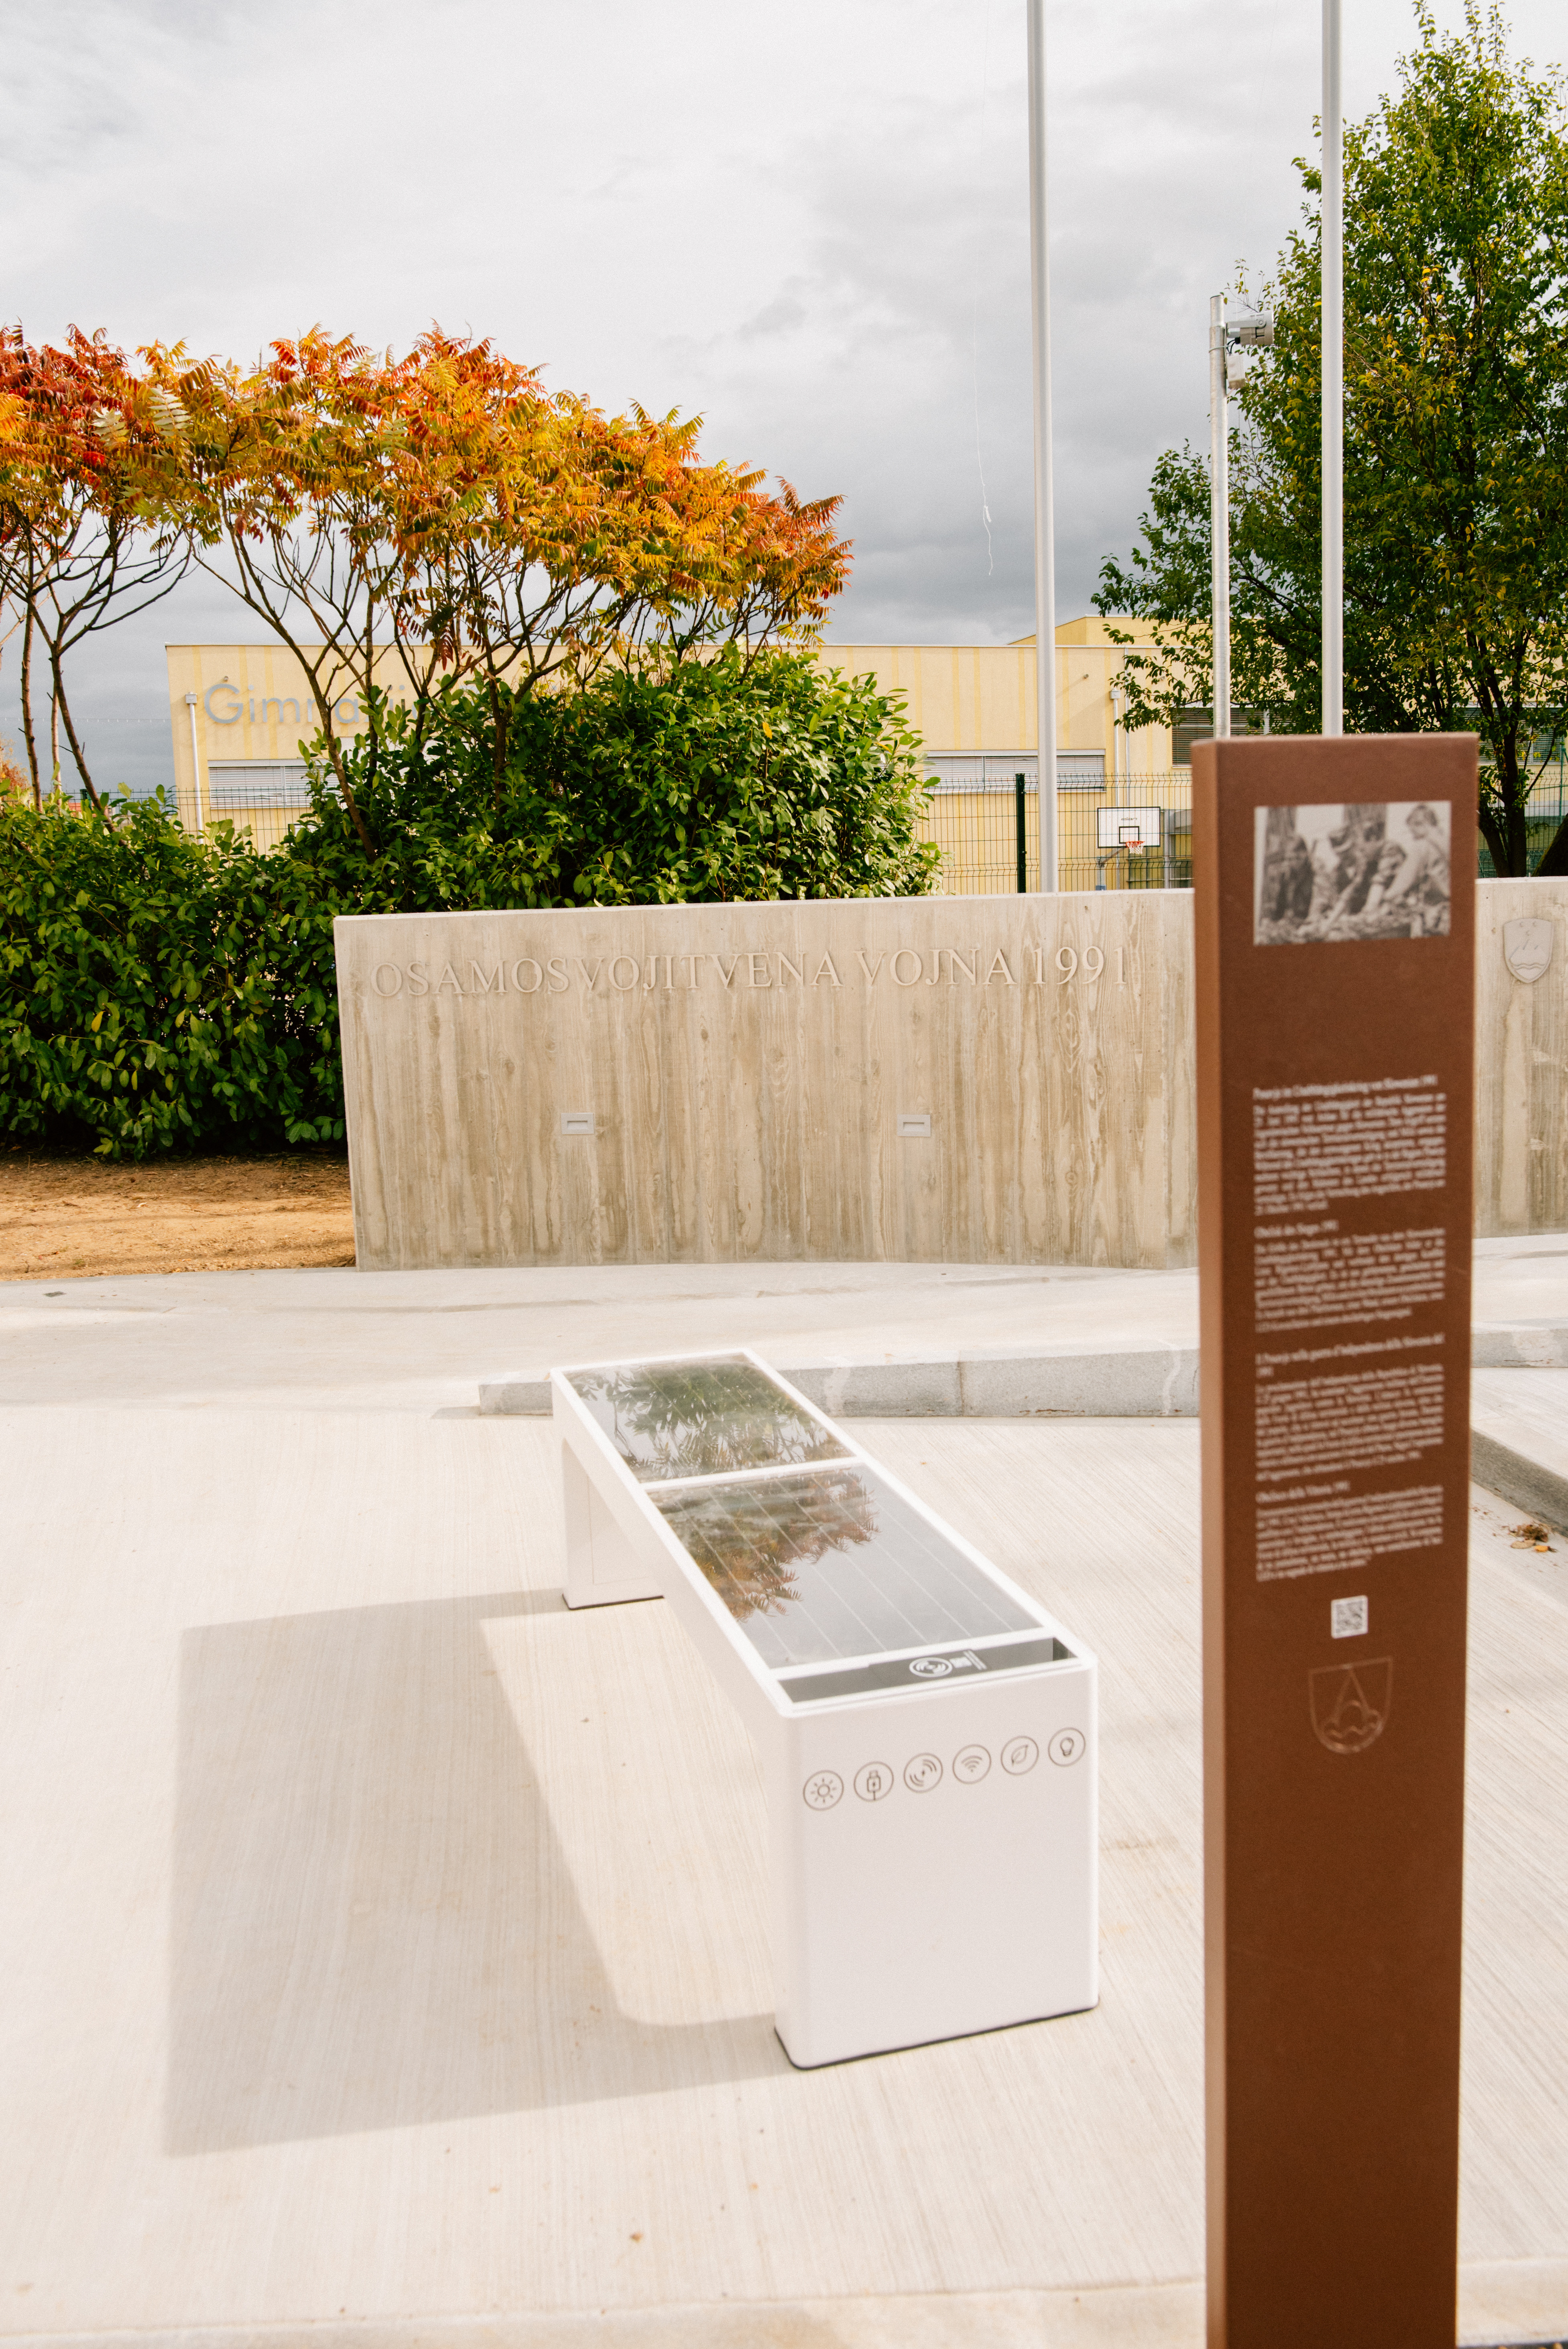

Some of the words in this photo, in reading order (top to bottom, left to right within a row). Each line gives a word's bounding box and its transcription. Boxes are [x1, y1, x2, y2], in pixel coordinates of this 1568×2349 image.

[370, 950, 843, 997] OSAMOSVOJITVENA
[853, 948, 1017, 986] VOJNA
[1033, 946, 1127, 985] 1991
